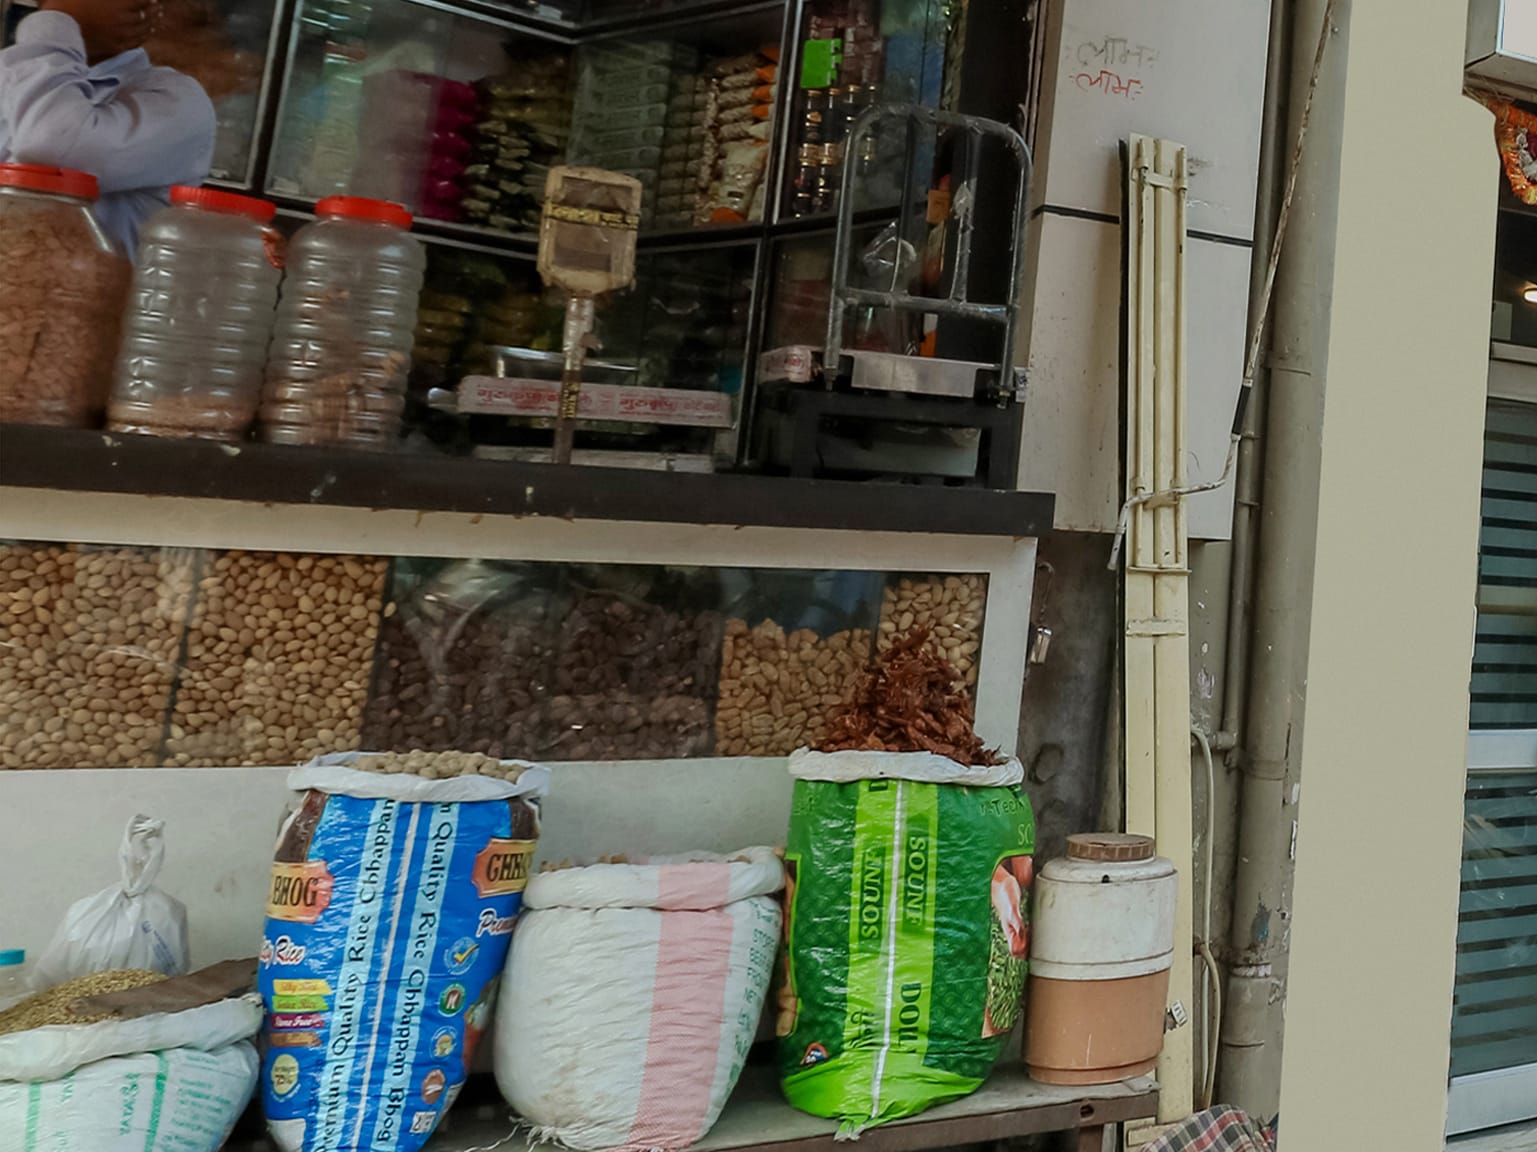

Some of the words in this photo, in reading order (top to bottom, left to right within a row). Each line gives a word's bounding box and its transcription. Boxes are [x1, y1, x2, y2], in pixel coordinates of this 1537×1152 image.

[358, 799, 395, 905] Chhappan
[424, 822, 453, 903] Quality
[272, 874, 319, 907] BHOG
[348, 914, 373, 963] Rice
[413, 913, 437, 960] Rice
[331, 973, 362, 1055] Quality
[392, 969, 425, 1078] Chhappan
[377, 1087, 404, 1143] Bhog
